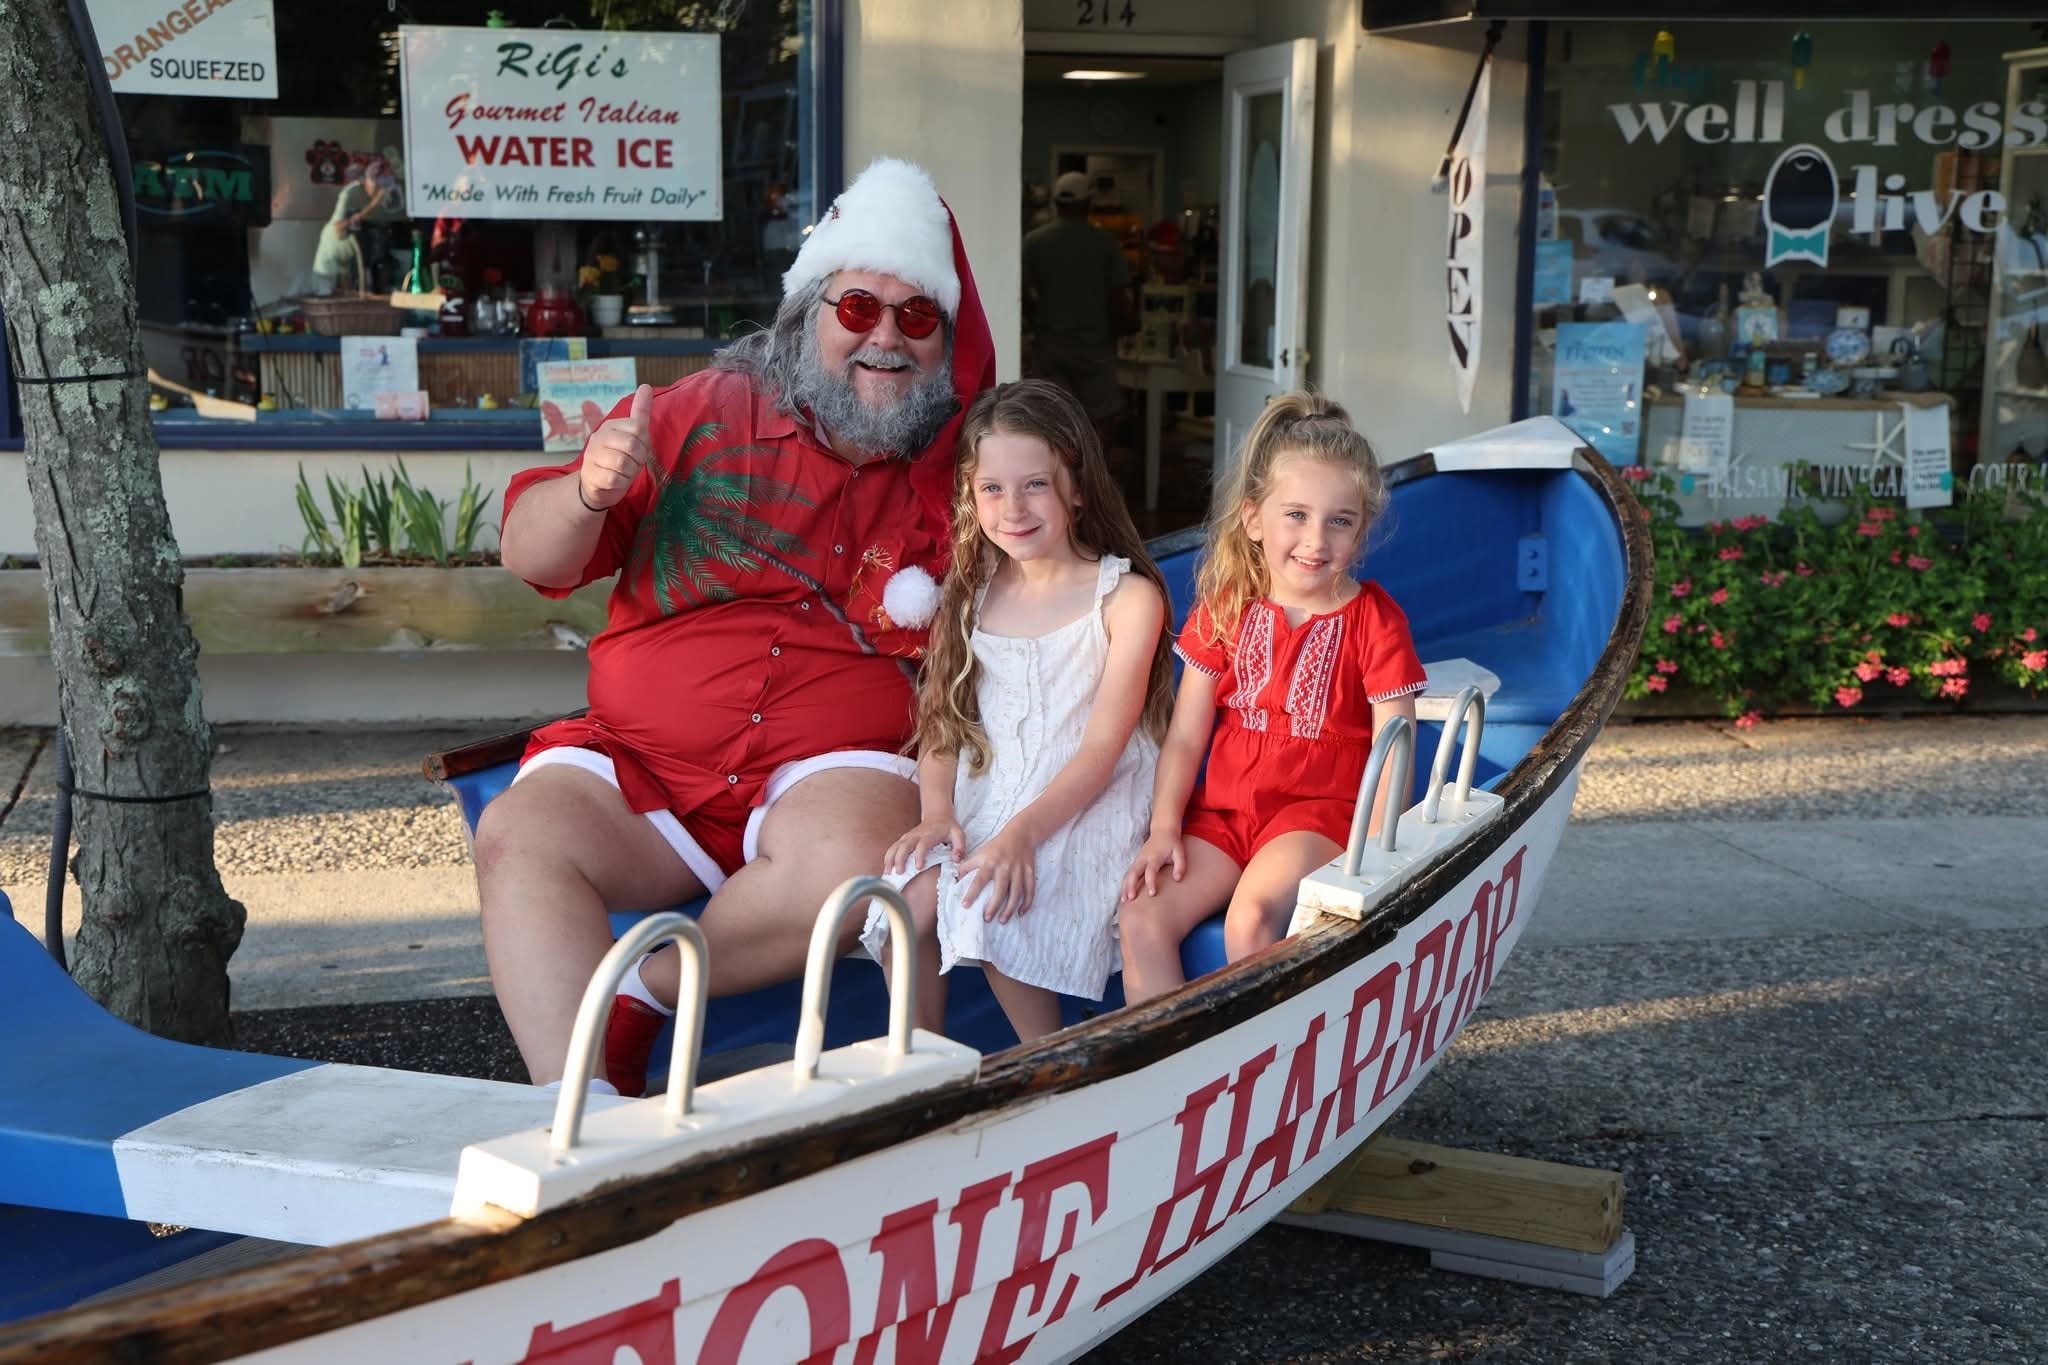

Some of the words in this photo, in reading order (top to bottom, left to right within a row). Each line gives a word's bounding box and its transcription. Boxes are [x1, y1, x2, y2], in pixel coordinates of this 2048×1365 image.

[1076, 0, 1136, 27] 214
[103, 0, 234, 81] ORANGEA
[150, 58, 265, 82] SQUEEZED
[445, 93, 566, 129] Gourmet
[578, 96, 680, 124] Italian
[1606, 80, 1785, 145] well
[456, 135, 596, 168] WATER
[617, 138, 673, 168] ICE
[133, 162, 253, 201] ATM
[496, 185, 539, 203] With
[547, 186, 595, 204] Fresh
[603, 187, 643, 205] Fruit
[1447, 158, 1475, 369] OPEN
[1093, 845, 1528, 1312] HARBOR
